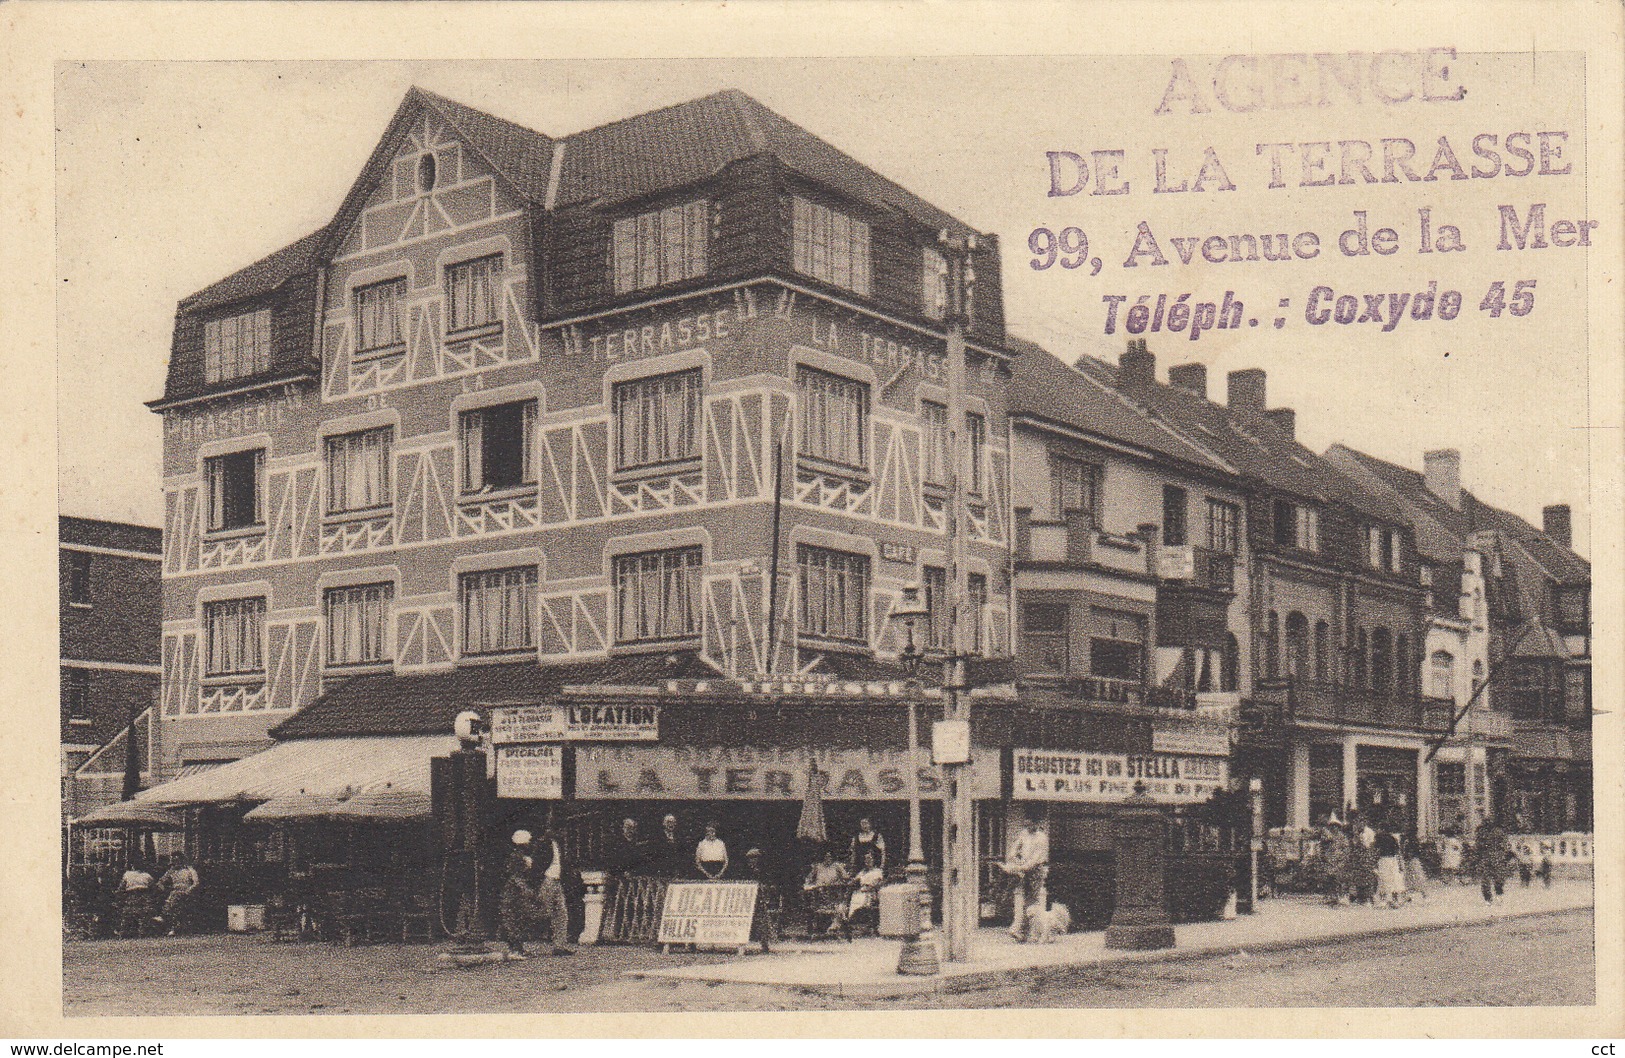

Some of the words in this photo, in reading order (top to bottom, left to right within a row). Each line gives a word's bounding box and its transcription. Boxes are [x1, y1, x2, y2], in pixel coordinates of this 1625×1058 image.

[569, 705, 655, 724] LOCATION
[1086, 757, 1103, 776] ICI
[1127, 755, 1180, 779] STELLA
[596, 768, 664, 794] LA
[691, 766, 977, 794] TERRASS
[665, 887, 755, 914] LOCATION
